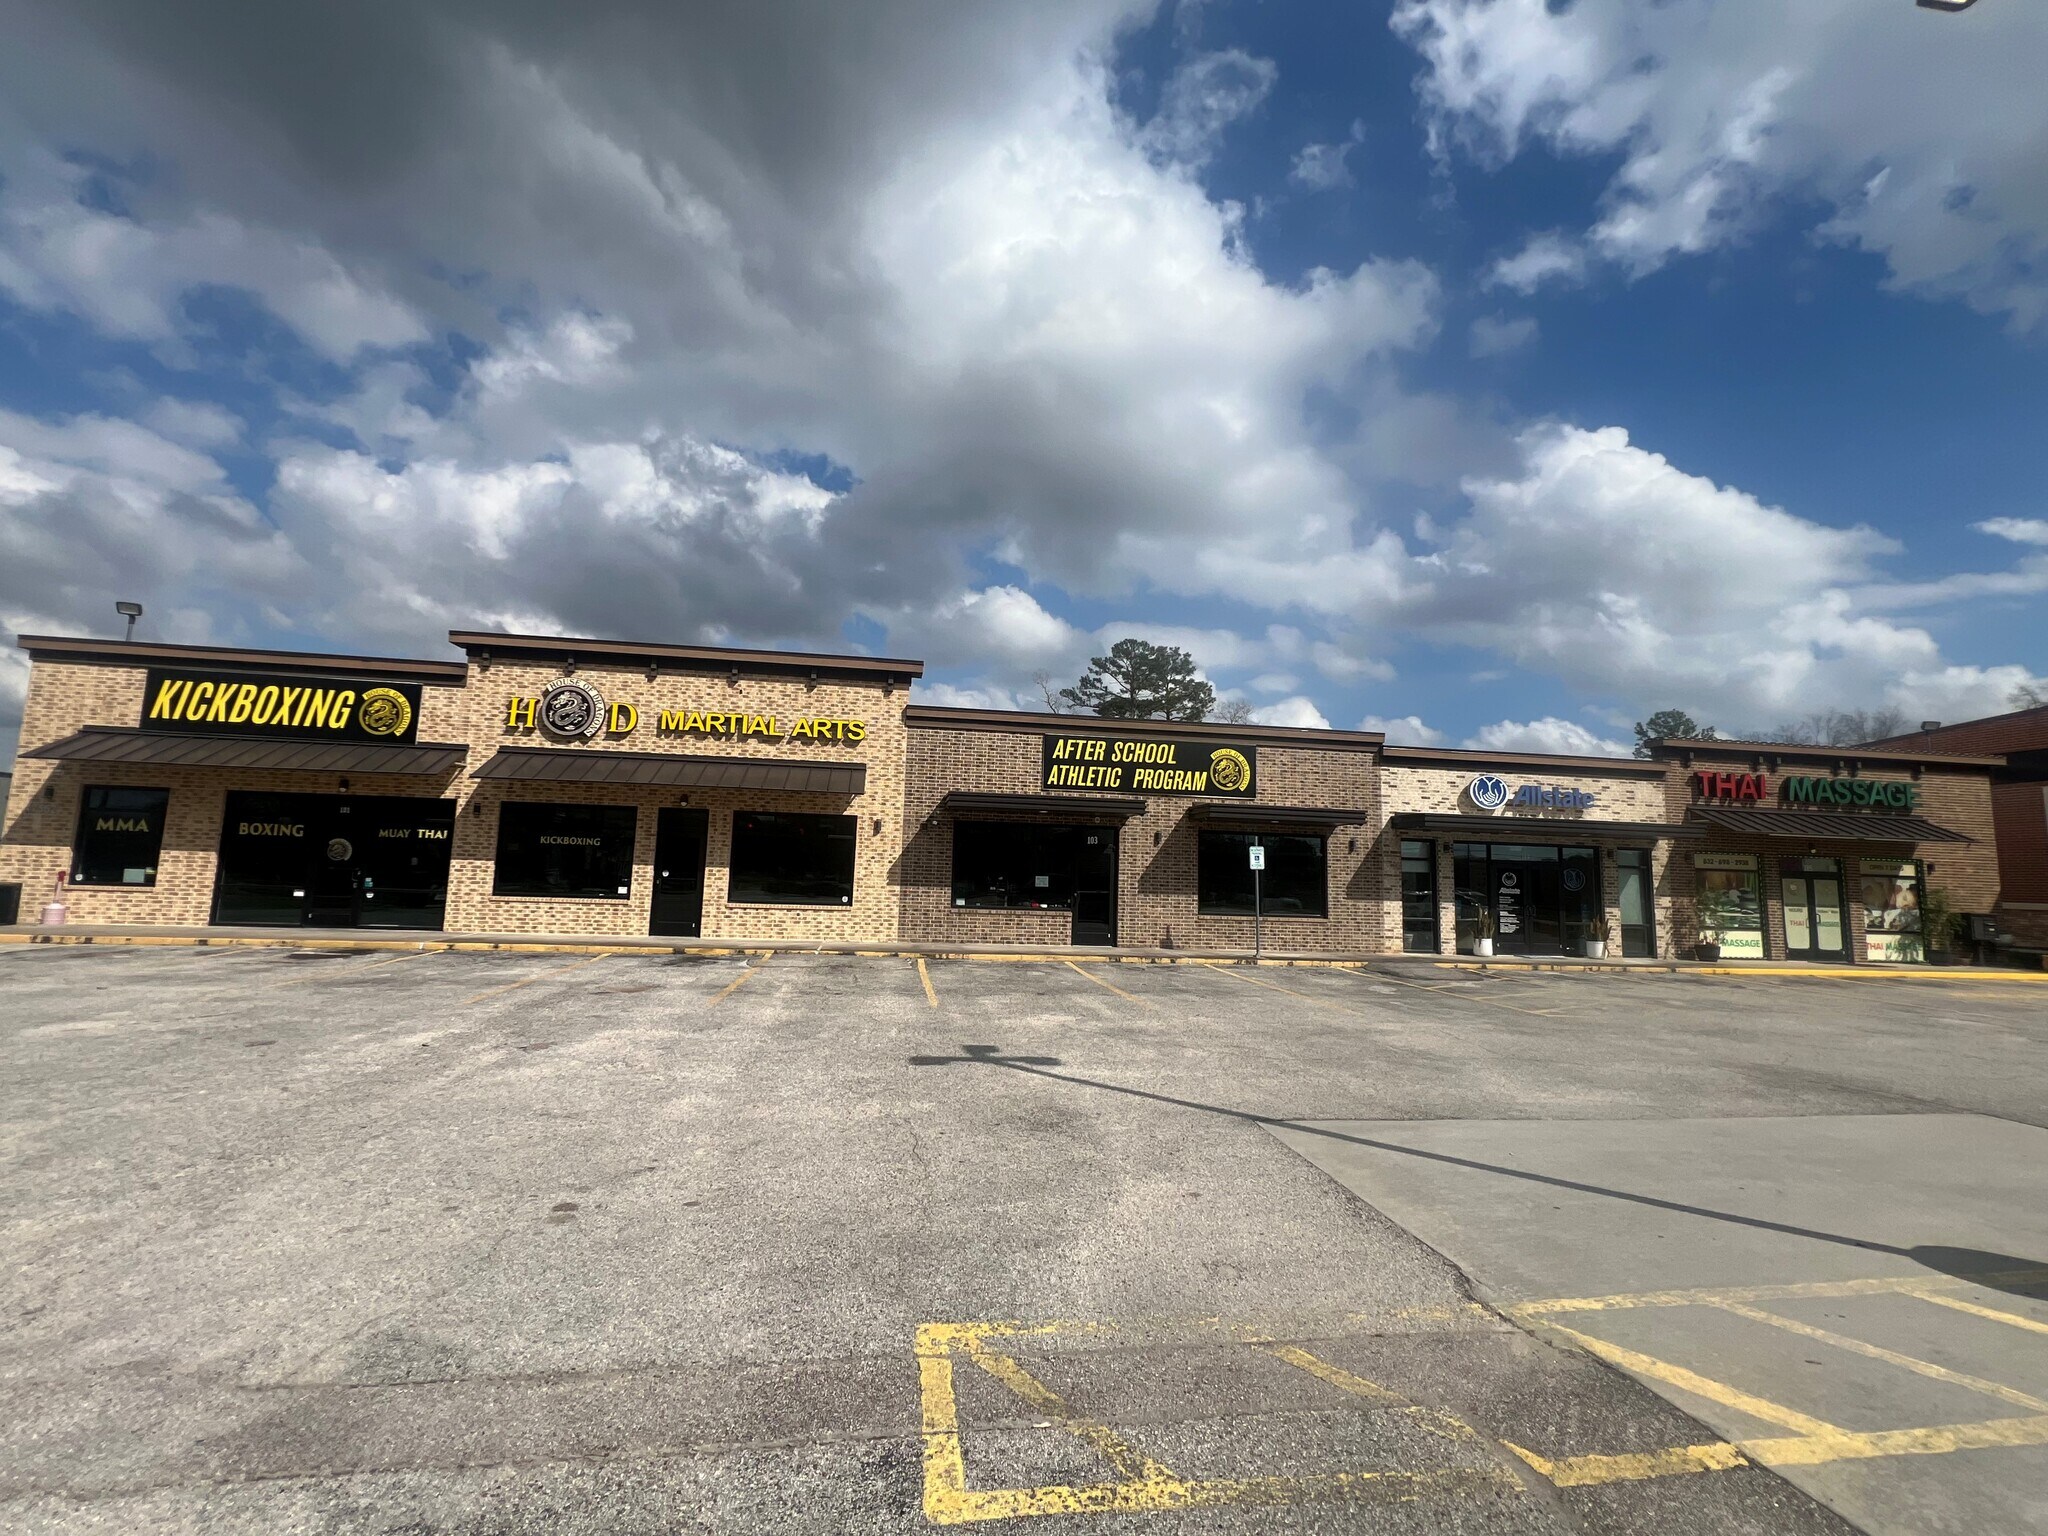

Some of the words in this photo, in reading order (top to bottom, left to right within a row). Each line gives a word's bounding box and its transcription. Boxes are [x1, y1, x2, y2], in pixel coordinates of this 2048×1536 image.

[549, 677, 581, 690] HOUSE
[583, 681, 595, 692] OF
[149, 680, 355, 729] KICKBOXING
[586, 694, 604, 736] DRAGONS
[507, 696, 537, 727] H
[607, 702, 638, 732] D
[660, 709, 785, 737] MARTIAL
[791, 717, 866, 741] ARTS
[1052, 739, 1106, 761] AFTER
[1111, 741, 1177, 764] SCHOOL
[1047, 765, 1122, 788] ATHLETIC
[1133, 768, 1208, 791] PROGRAM
[1697, 771, 1766, 800] THAI
[1788, 776, 1921, 808] MASSAGE
[1512, 784, 1595, 809] Allstate
[96, 817, 149, 832] MMA
[239, 822, 304, 837] BOXING
[378, 829, 411, 838] MUAY
[417, 829, 448, 839] THAI
[540, 836, 601, 846] KICKBOXING
